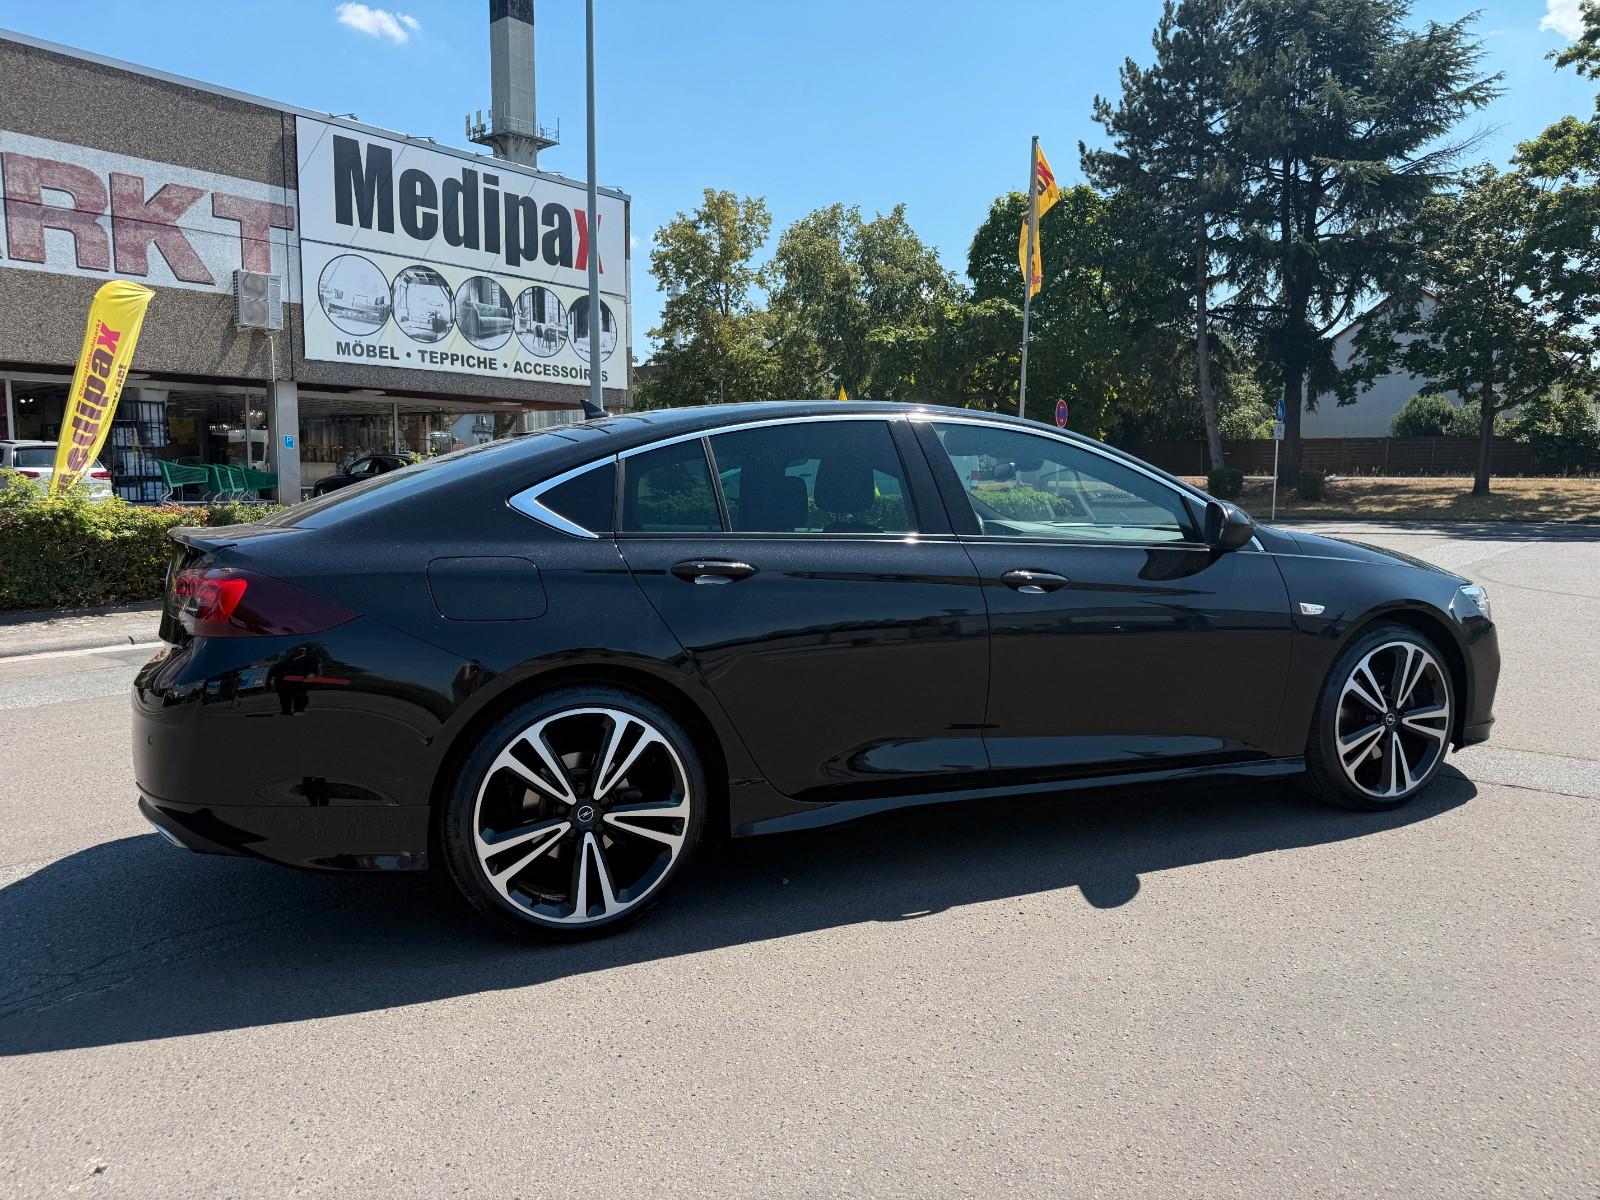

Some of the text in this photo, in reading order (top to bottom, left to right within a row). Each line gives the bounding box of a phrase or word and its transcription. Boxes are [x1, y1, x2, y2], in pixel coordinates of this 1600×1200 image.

[0, 152, 295, 286] RKT
[332, 134, 604, 275] Medipax
[335, 340, 400, 361] MÖBEL
[417, 350, 498, 371] TEPPICHE
